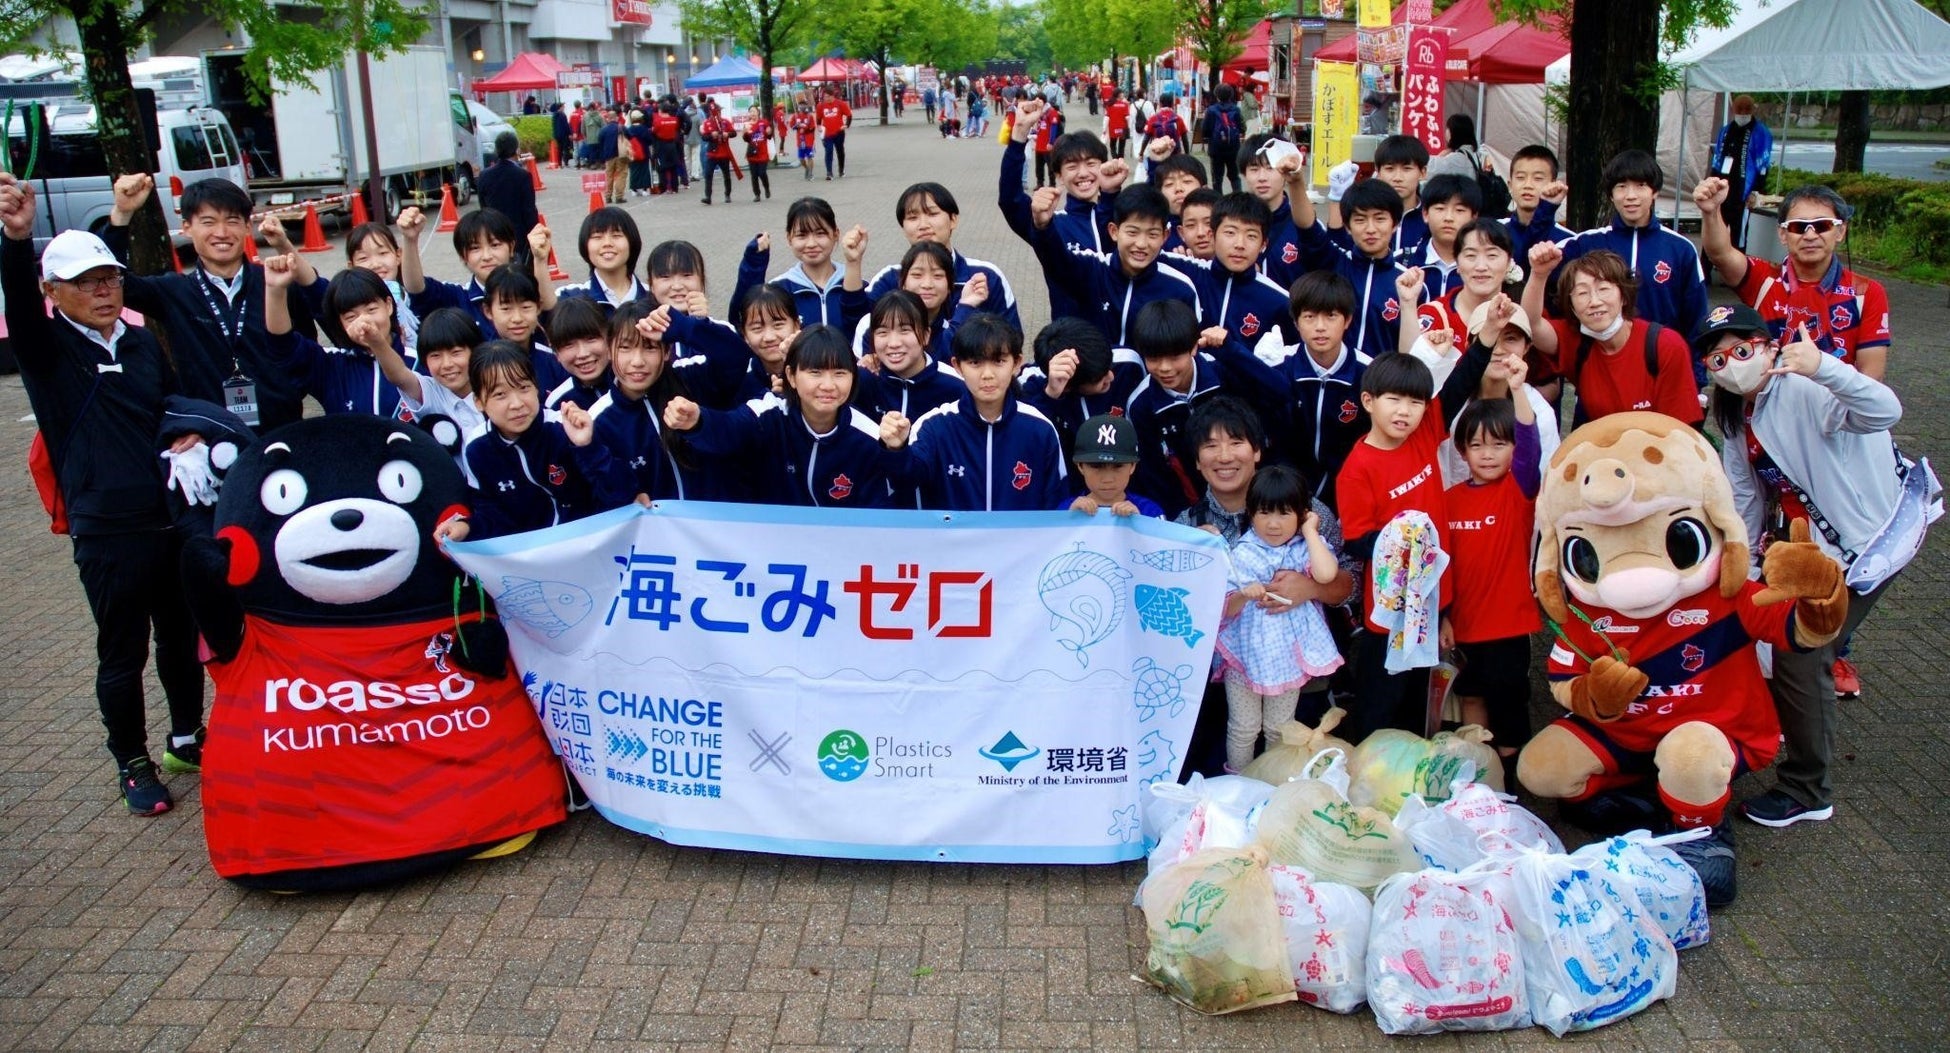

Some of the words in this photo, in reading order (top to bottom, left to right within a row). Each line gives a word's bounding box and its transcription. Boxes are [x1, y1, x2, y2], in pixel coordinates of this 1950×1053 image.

[1418, 44, 1434, 64] Rb
[1407, 74, 1424, 138] パンケー
[1424, 76, 1441, 149] ふわふわ
[1321, 83, 1336, 168] かぼすエール
[1097, 424, 1117, 445] NY
[1389, 472, 1426, 499] IWAKI
[1484, 515, 1496, 525] C
[605, 545, 992, 640] 海ごみゼロ
[264, 672, 475, 714] roasso
[550, 682, 589, 709] 日本
[1646, 684, 1704, 696] AKI
[597, 690, 723, 728] CHANGE
[1657, 702, 1673, 714] C
[263, 706, 491, 752] kumamoto
[550, 708, 592, 736] 財団
[651, 728, 686, 746] FOR
[690, 731, 722, 749] THE
[875, 736, 952, 758] Plastics
[566, 759, 597, 777] OJECT
[651, 748, 722, 781] BLUE
[873, 757, 934, 779] Smart
[1046, 747, 1129, 773] 環境省
[606, 767, 722, 798] 海の未来を変える挑戦
[978, 775, 1025, 786] Ministry
[1028, 775, 1040, 785] of
[1043, 775, 1060, 785] the
[1063, 774, 1129, 785] Environment
